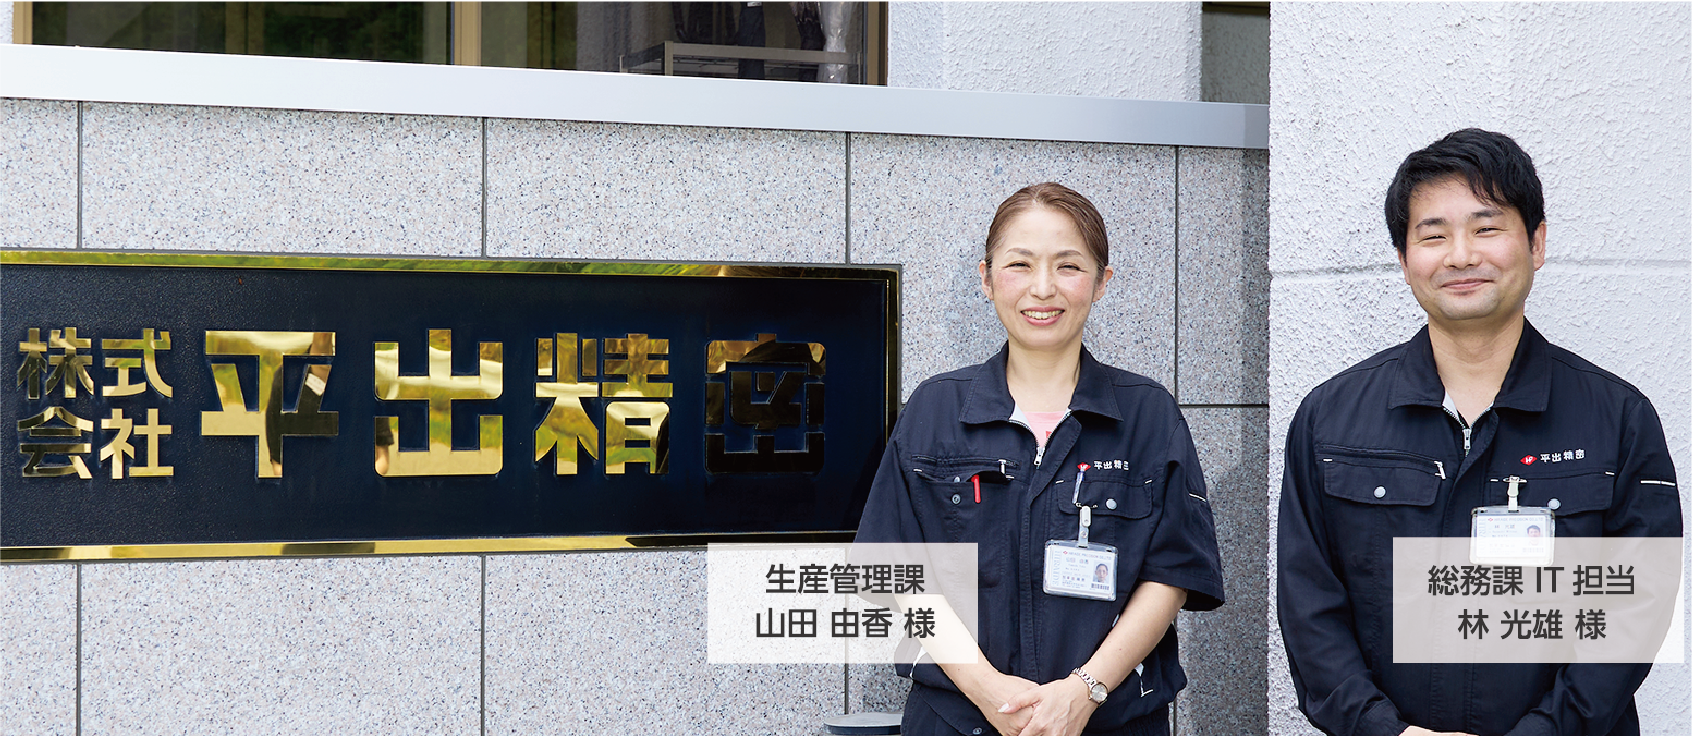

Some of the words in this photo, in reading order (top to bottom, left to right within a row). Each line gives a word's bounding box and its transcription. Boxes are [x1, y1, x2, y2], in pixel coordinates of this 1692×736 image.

[17, 327, 173, 399] 株式
[201, 327, 826, 478] 平出精密
[18, 406, 174, 479] 会社
[1540, 449, 1585, 463] 平出精密
